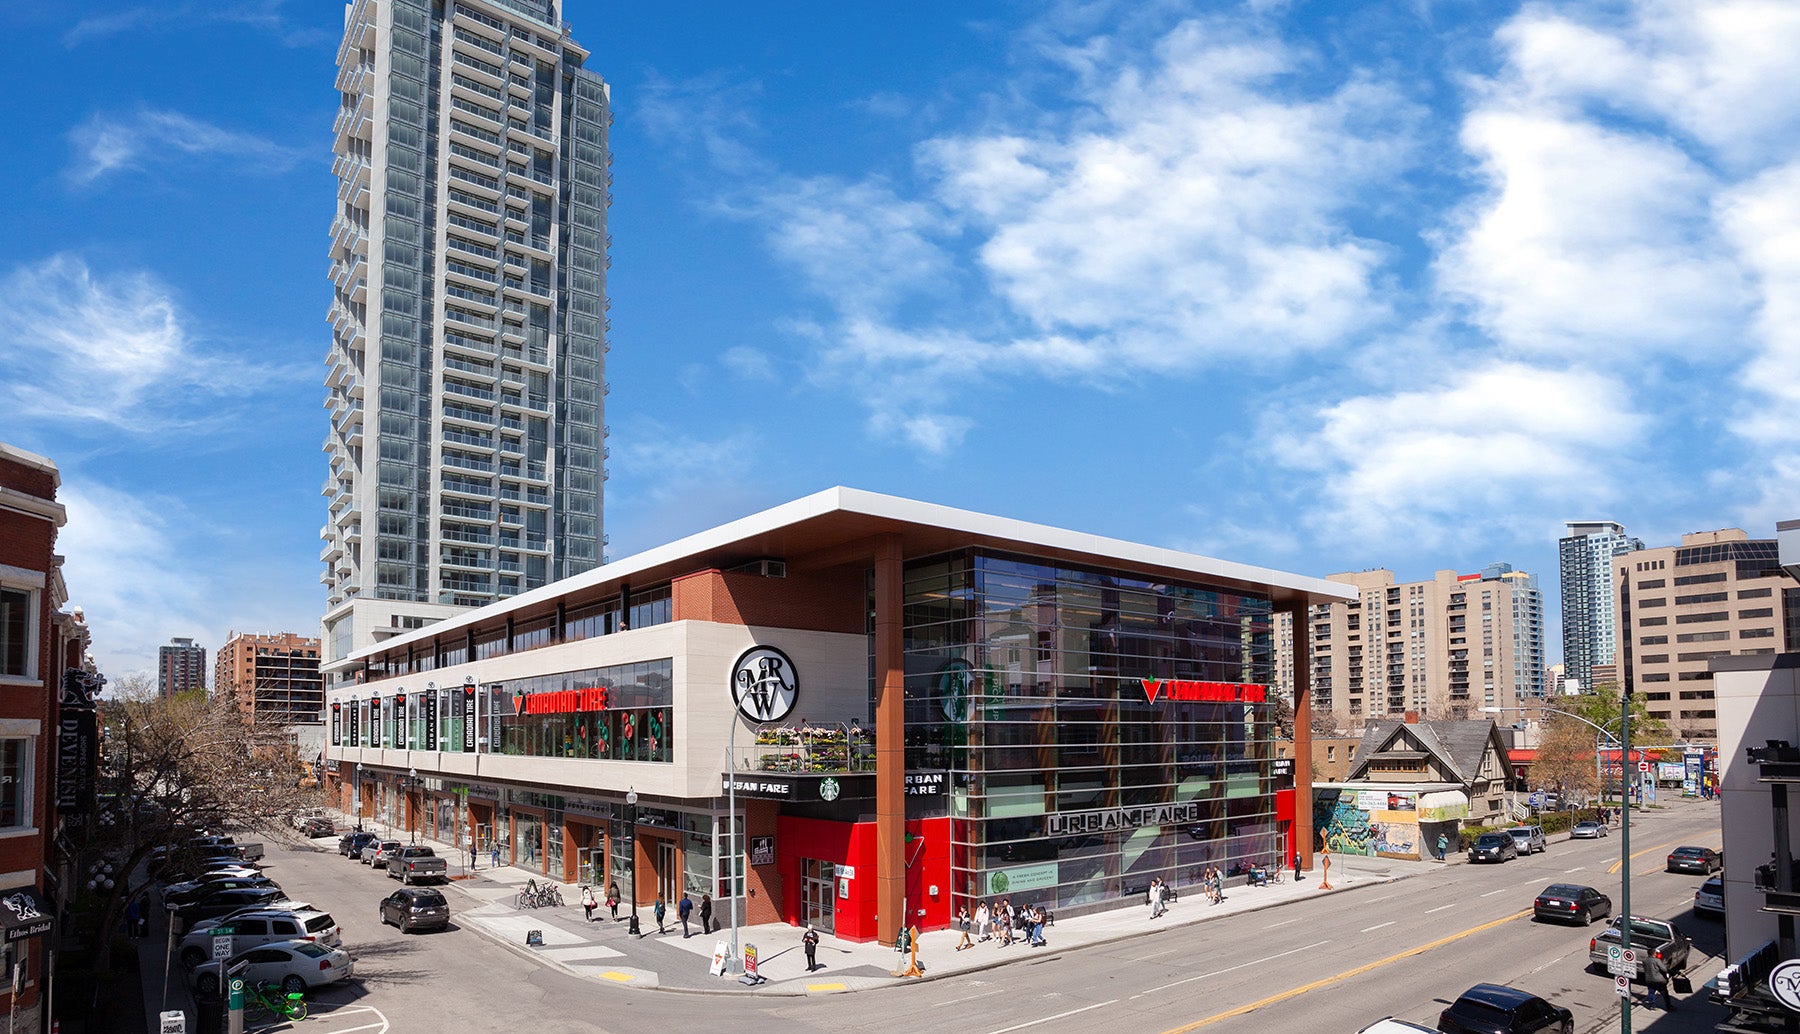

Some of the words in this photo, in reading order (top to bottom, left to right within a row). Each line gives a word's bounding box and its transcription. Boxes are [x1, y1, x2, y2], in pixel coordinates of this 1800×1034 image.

[466, 699, 474, 713] TIRE
[526, 690, 577, 714] CANADIAN
[579, 687, 607, 711] TIRE
[466, 715, 474, 747] CANADIAN
[61, 719, 79, 807] DEVENISH
[905, 774, 943, 784] RBAN
[759, 783, 789, 794] FARE
[1049, 810, 1135, 835] URBAN
[1141, 803, 1199, 826] FARE
[10, 929, 29, 939] Ethos
[30, 922, 51, 934] Bridal
[214, 949, 230, 957] WAY
